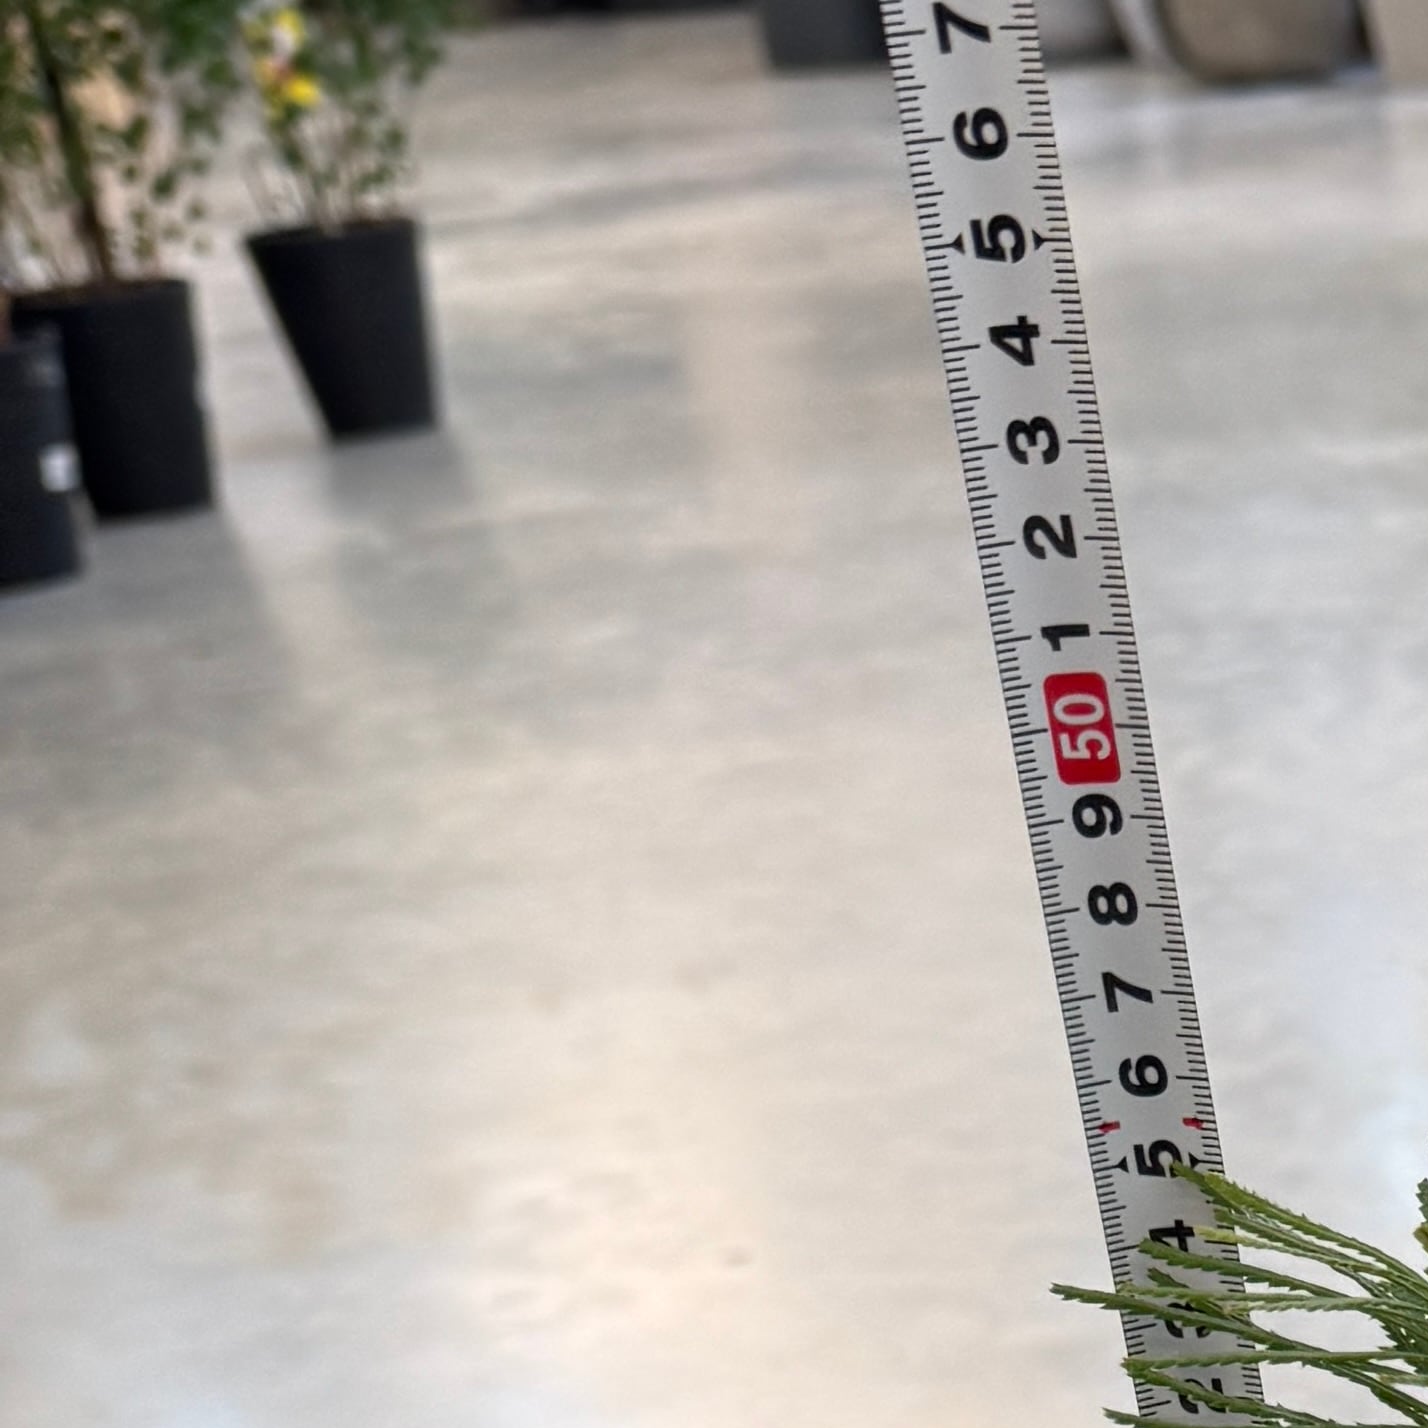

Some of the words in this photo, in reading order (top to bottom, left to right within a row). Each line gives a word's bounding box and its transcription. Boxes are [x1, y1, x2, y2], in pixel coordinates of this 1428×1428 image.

[933, 2, 991, 54] 7
[953, 107, 1008, 160] 6
[970, 214, 1026, 263] 5
[989, 315, 1040, 366] 4
[1006, 416, 1060, 464] 3
[1023, 515, 1077, 559] 2
[1041, 624, 1090, 651] 1
[1053, 692, 1112, 761] 50
[1072, 794, 1123, 838] 9
[1088, 882, 1138, 926] 8
[1102, 972, 1153, 1012] 7
[1119, 1055, 1168, 1097] 6
[1133, 1140, 1183, 1178] 5
[1149, 1220, 1195, 1253] 4
